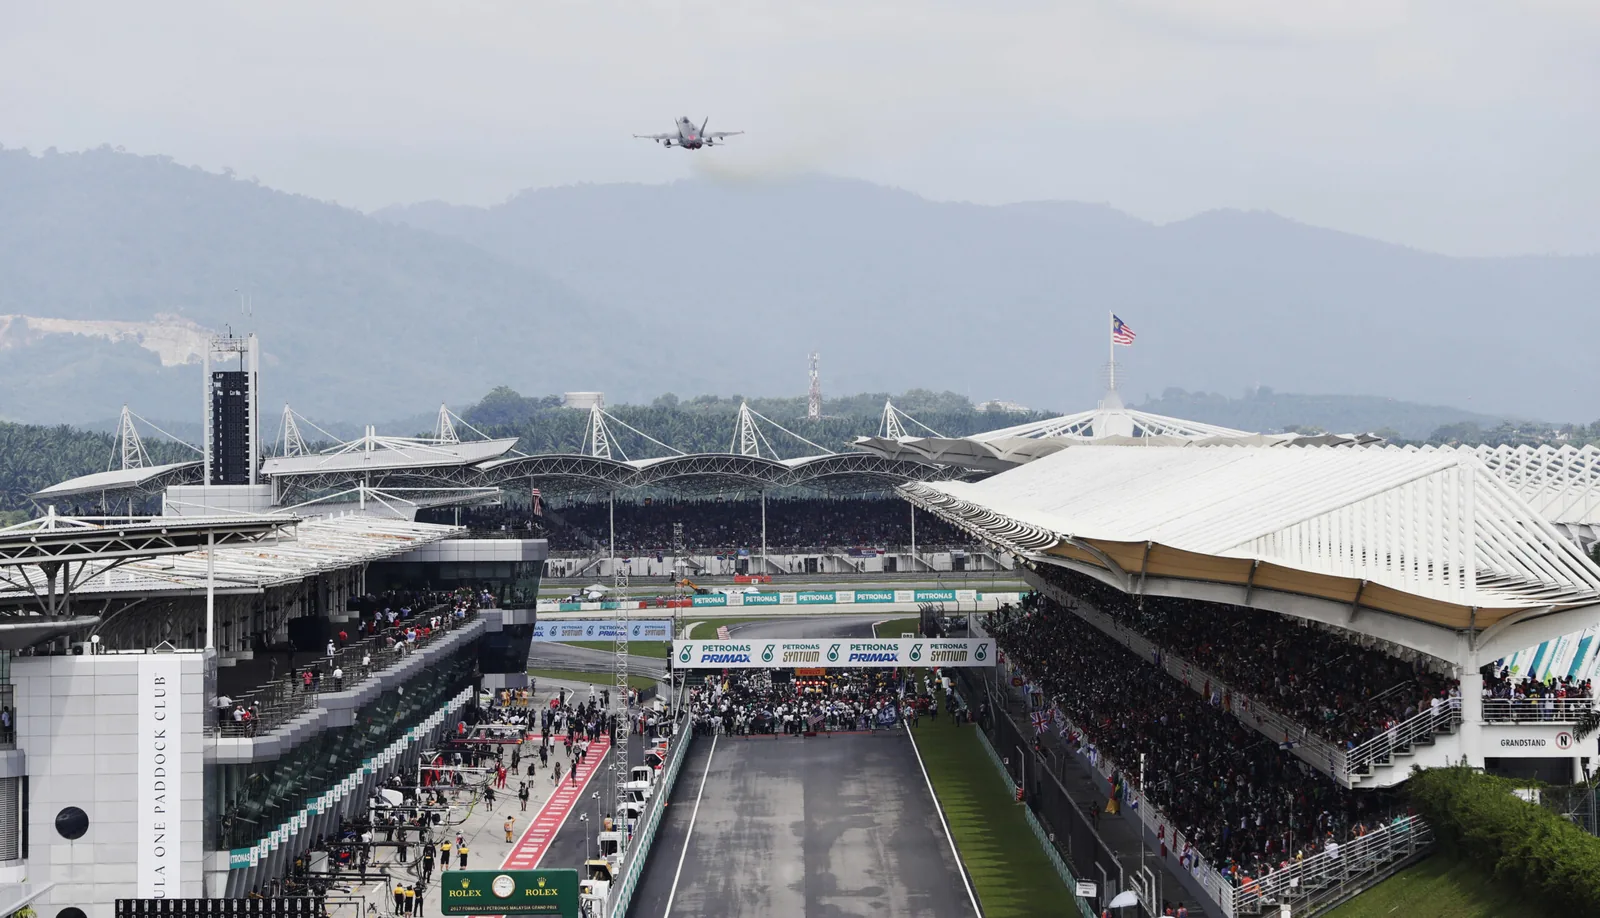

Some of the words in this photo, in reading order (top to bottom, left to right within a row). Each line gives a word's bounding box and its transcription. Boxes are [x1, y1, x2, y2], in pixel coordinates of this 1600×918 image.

[701, 654, 751, 663] PRIMAX
[782, 651, 820, 662] SYNTIUM
[849, 653, 899, 662] PRIMAX
[930, 651, 968, 662] SYNTIUM
[1560, 736, 1567, 746] N
[154, 729, 166, 814] PADDOCK
[154, 822, 166, 858] ONE
[154, 865, 166, 899] ULA
